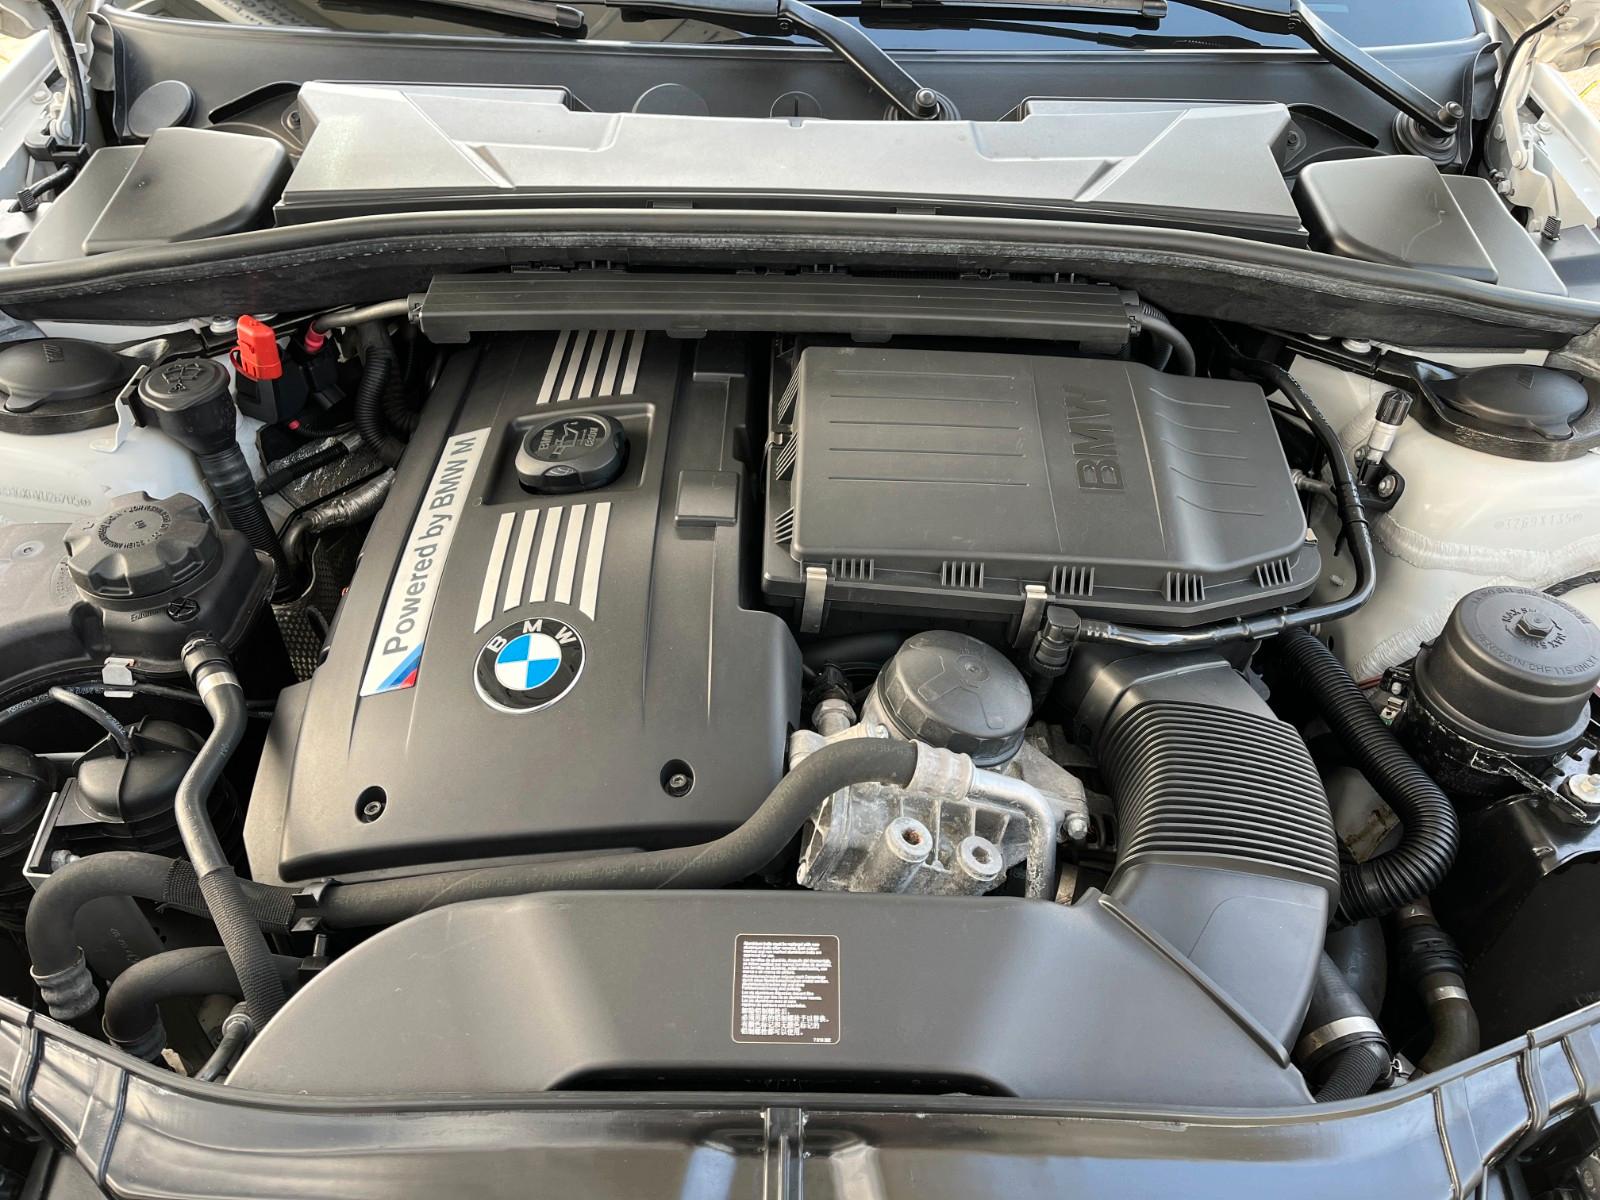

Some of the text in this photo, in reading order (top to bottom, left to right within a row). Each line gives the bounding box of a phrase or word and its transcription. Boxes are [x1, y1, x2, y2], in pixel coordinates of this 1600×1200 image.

[1063, 384, 1125, 491] BMW
[383, 436, 477, 656] Powered by BMW M
[486, 619, 577, 653] BMW
